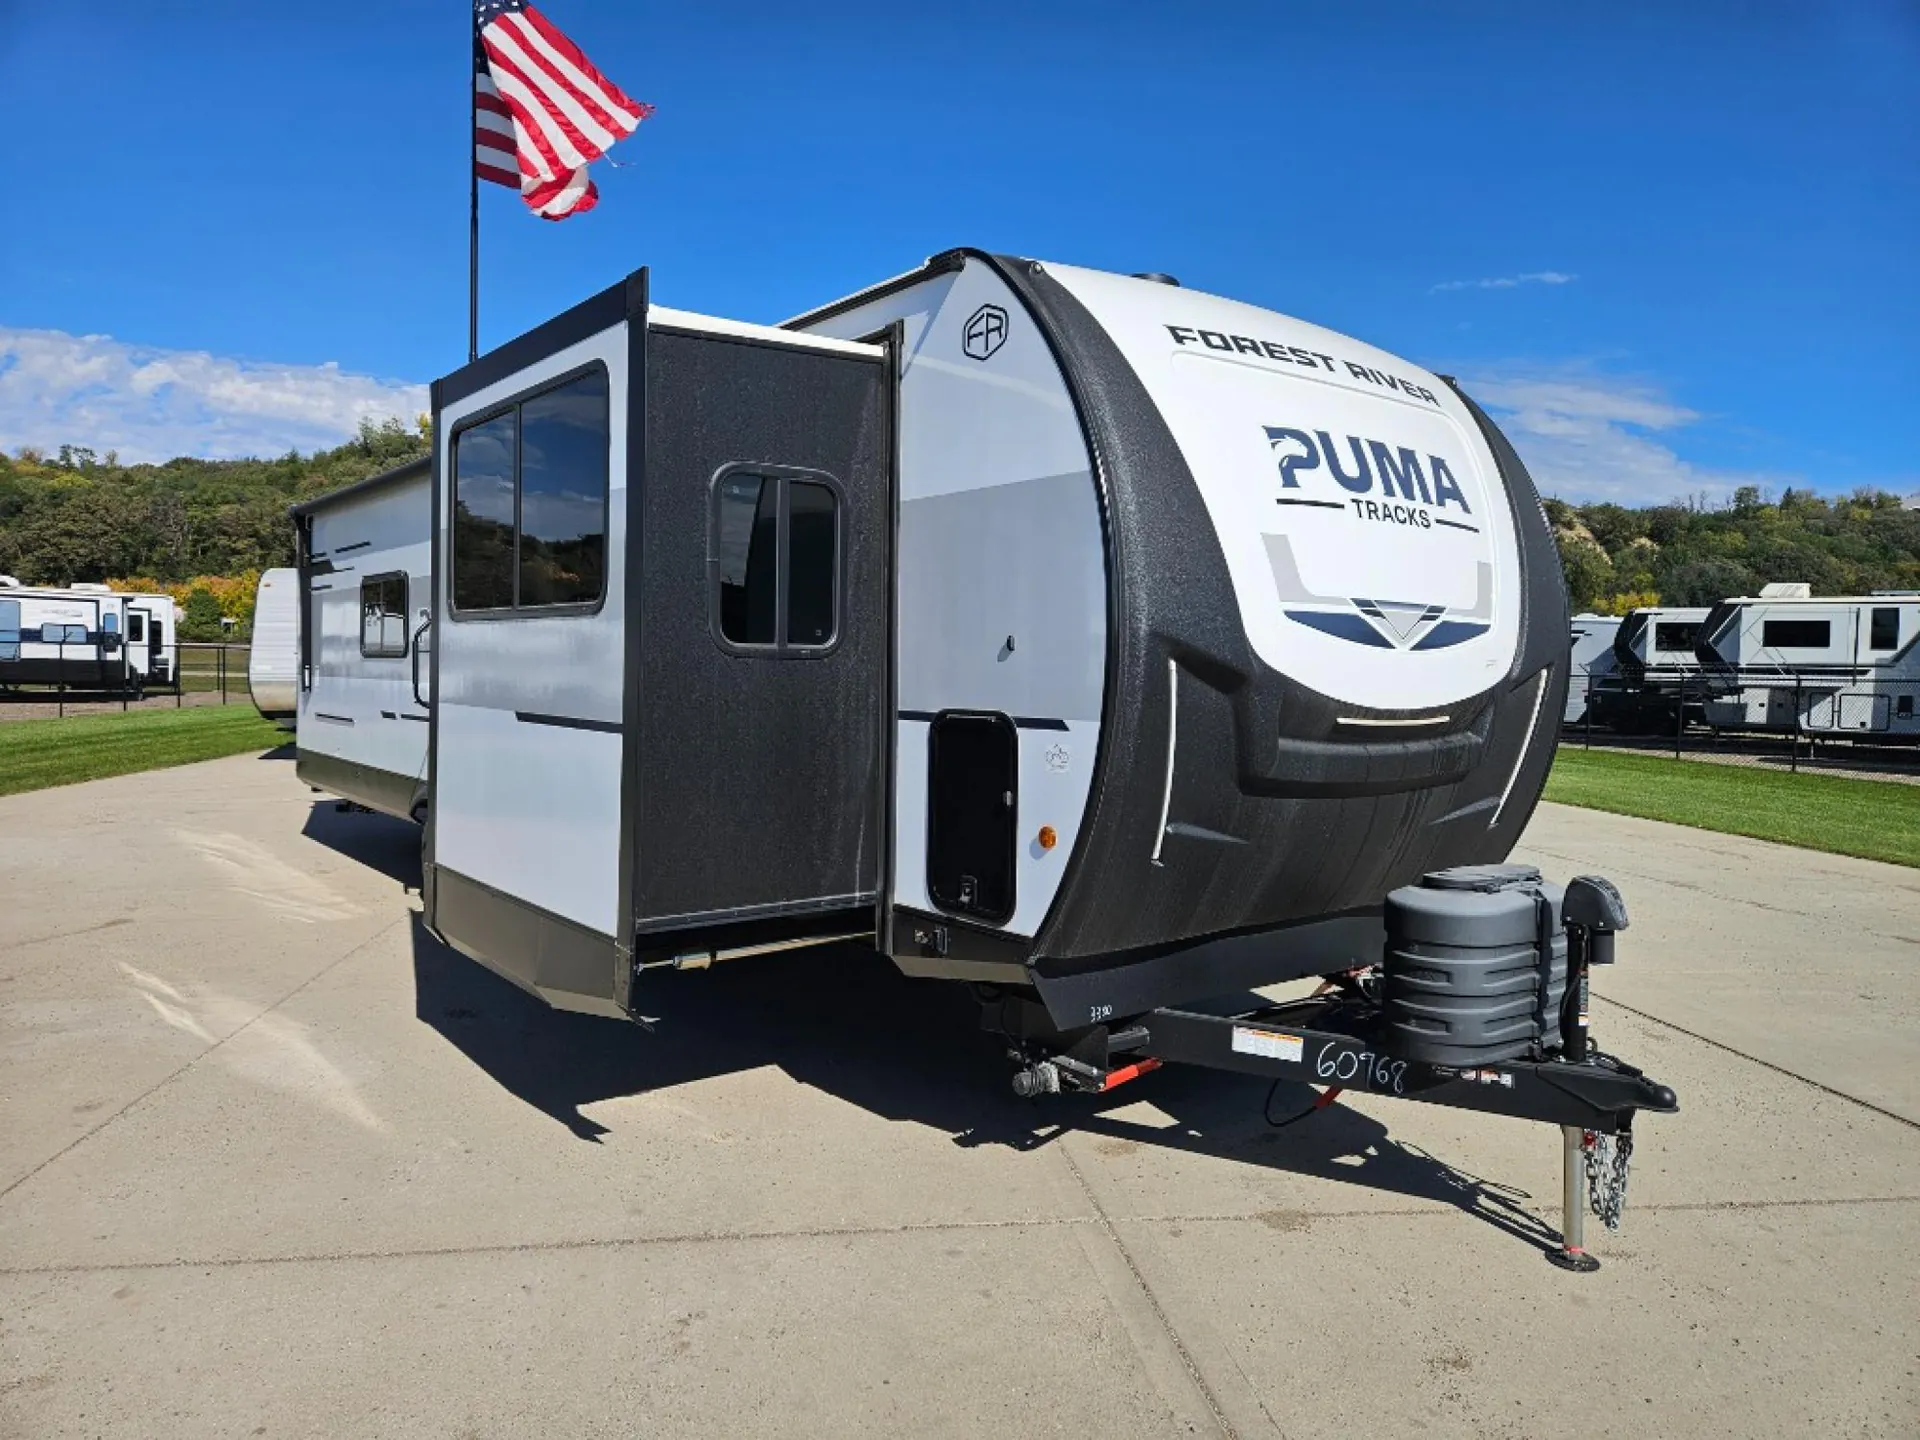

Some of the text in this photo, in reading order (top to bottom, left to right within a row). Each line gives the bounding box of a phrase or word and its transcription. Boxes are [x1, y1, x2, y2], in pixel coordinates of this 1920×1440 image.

[1164, 324, 1441, 407] FOREST RIVER
[1262, 425, 1471, 514] PUMA
[1351, 499, 1431, 529] TRACKS
